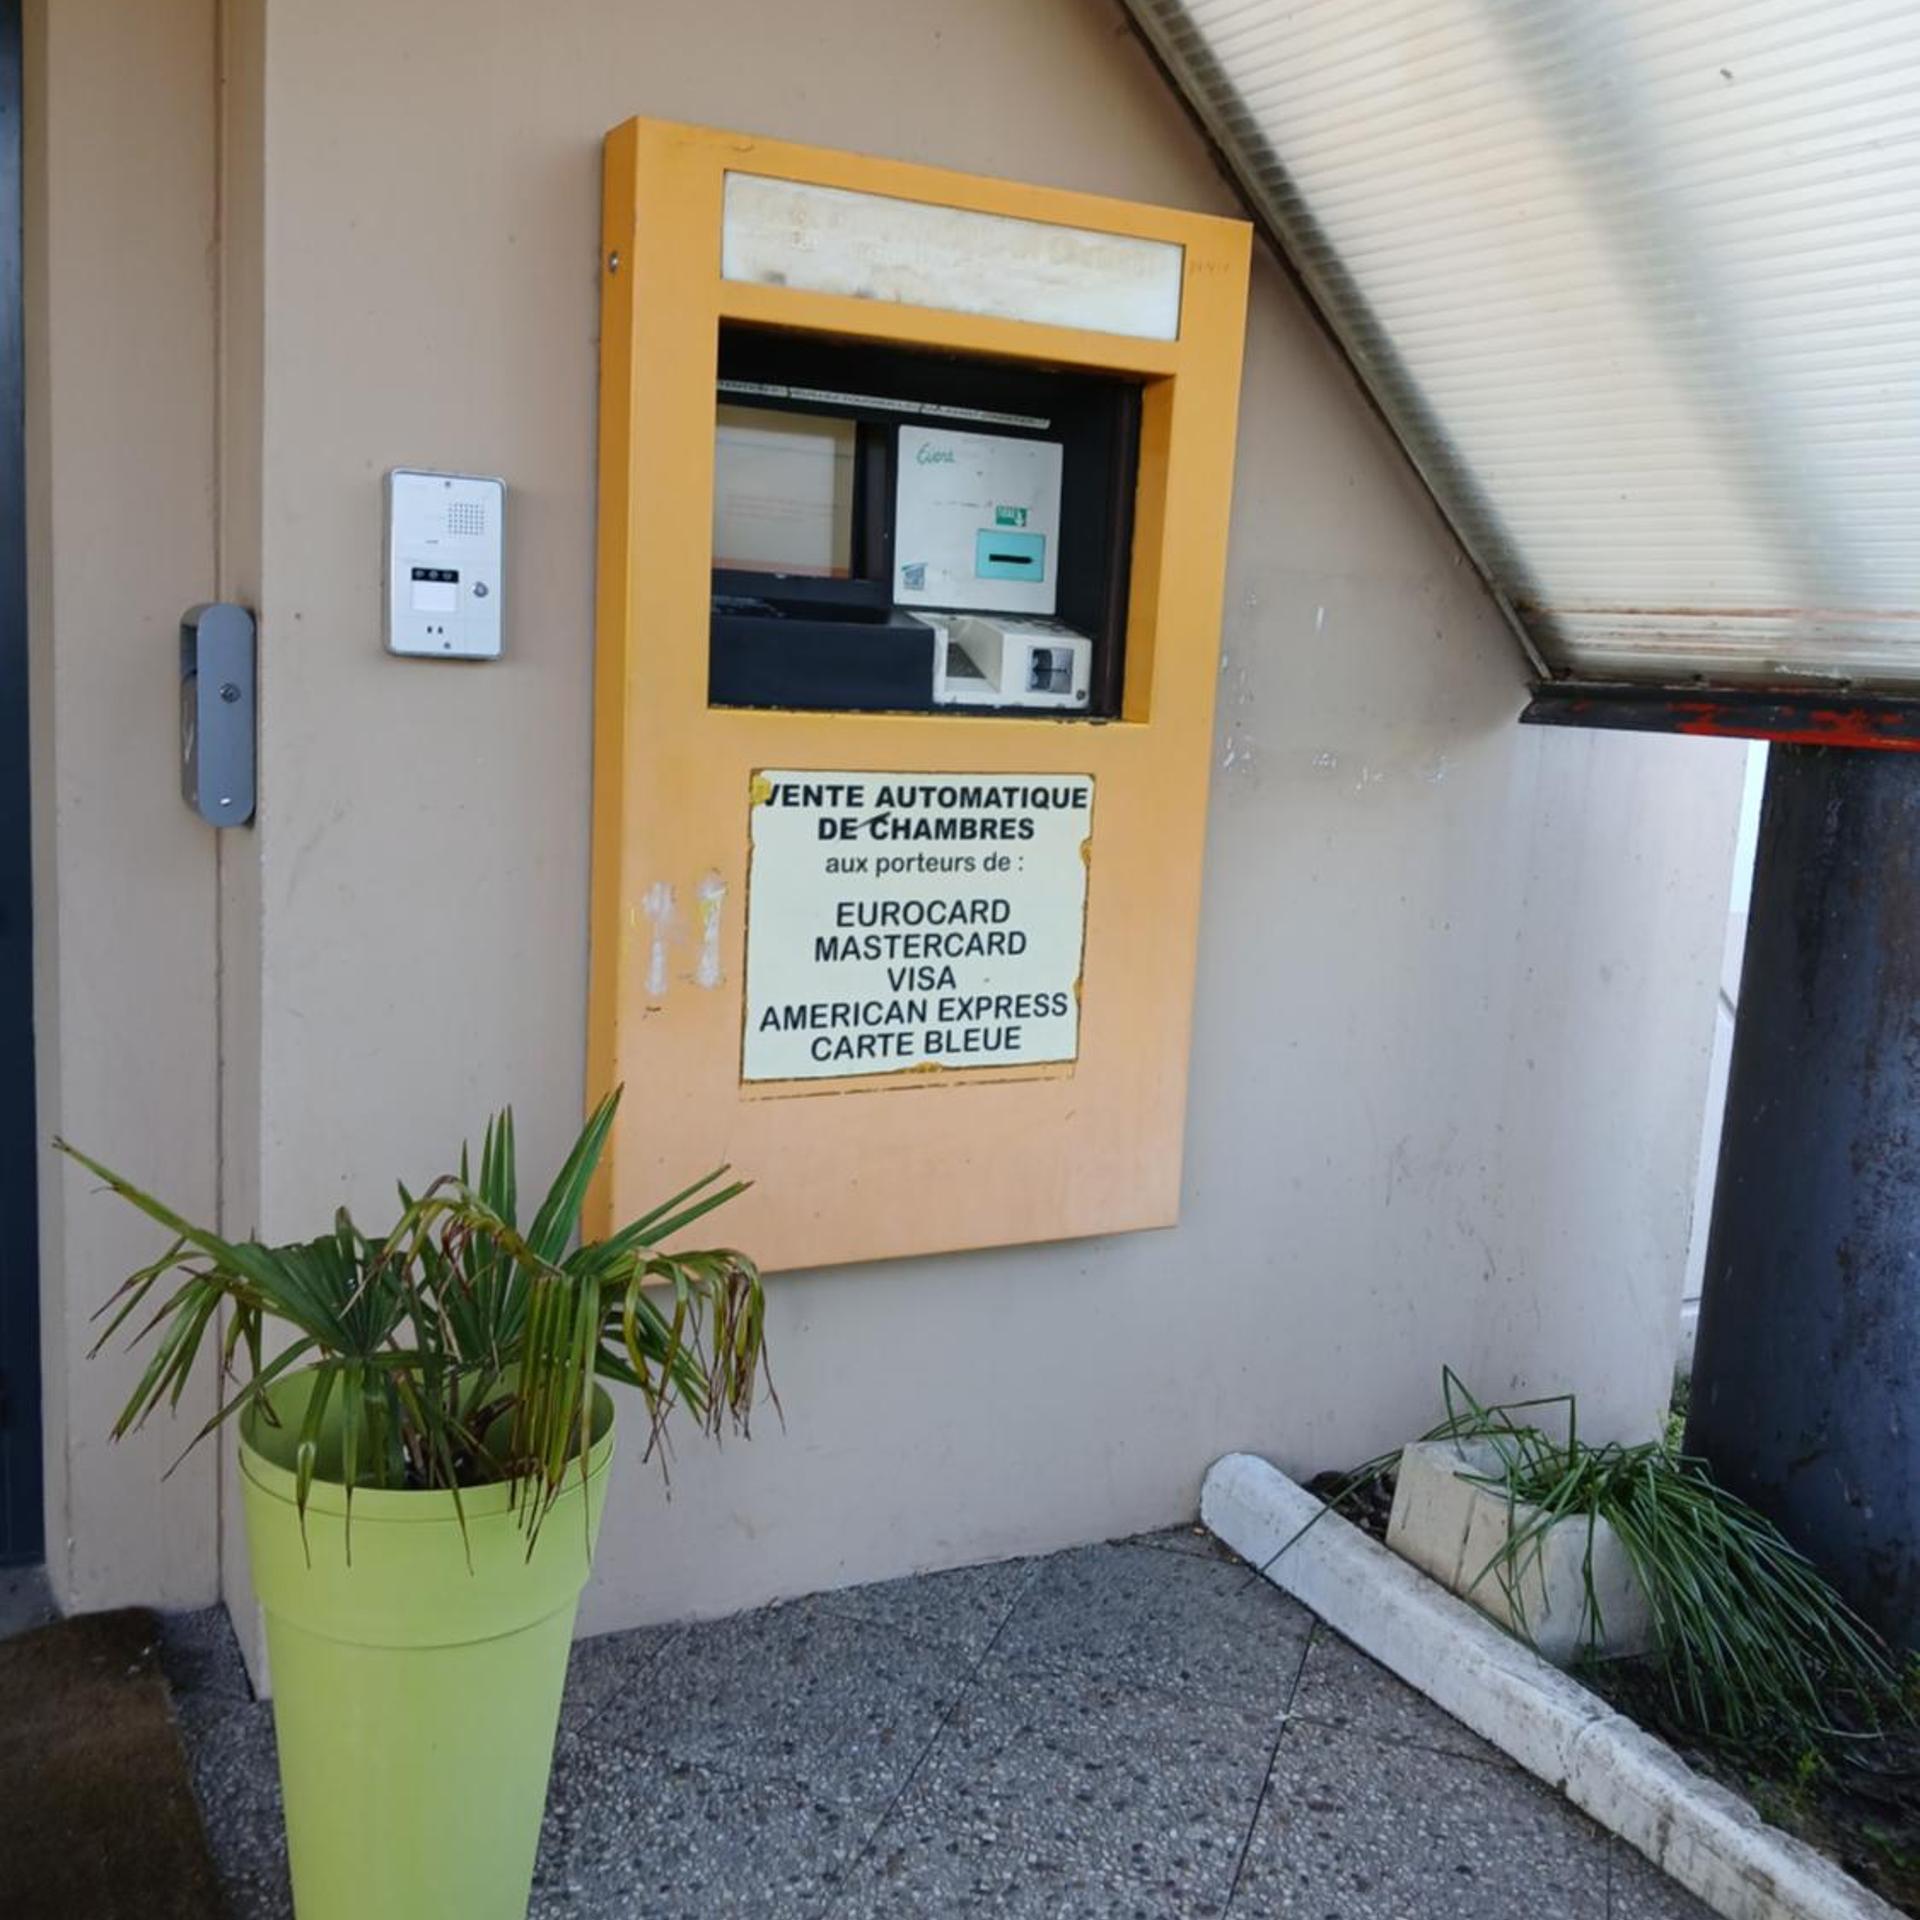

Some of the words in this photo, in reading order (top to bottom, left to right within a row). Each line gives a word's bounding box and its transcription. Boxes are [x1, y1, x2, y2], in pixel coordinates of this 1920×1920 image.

[764, 784, 864, 808] VENTE
[875, 785, 1088, 810] AUTOMATIQUE
[818, 818, 858, 841] DE
[868, 813, 1034, 841] CHAMBRES
[825, 857, 868, 874] aux
[875, 853, 976, 877] porteurs
[982, 851, 1011, 872] de
[836, 899, 1011, 928] EUROCARD
[814, 931, 1027, 963] MASTERCARD
[887, 965, 957, 992] VISA
[759, 1000, 928, 1032] AMERICAN
[937, 992, 1068, 1023] EXPRESS
[810, 1032, 914, 1062] CARTE
[924, 1026, 1022, 1055] BLEUE
